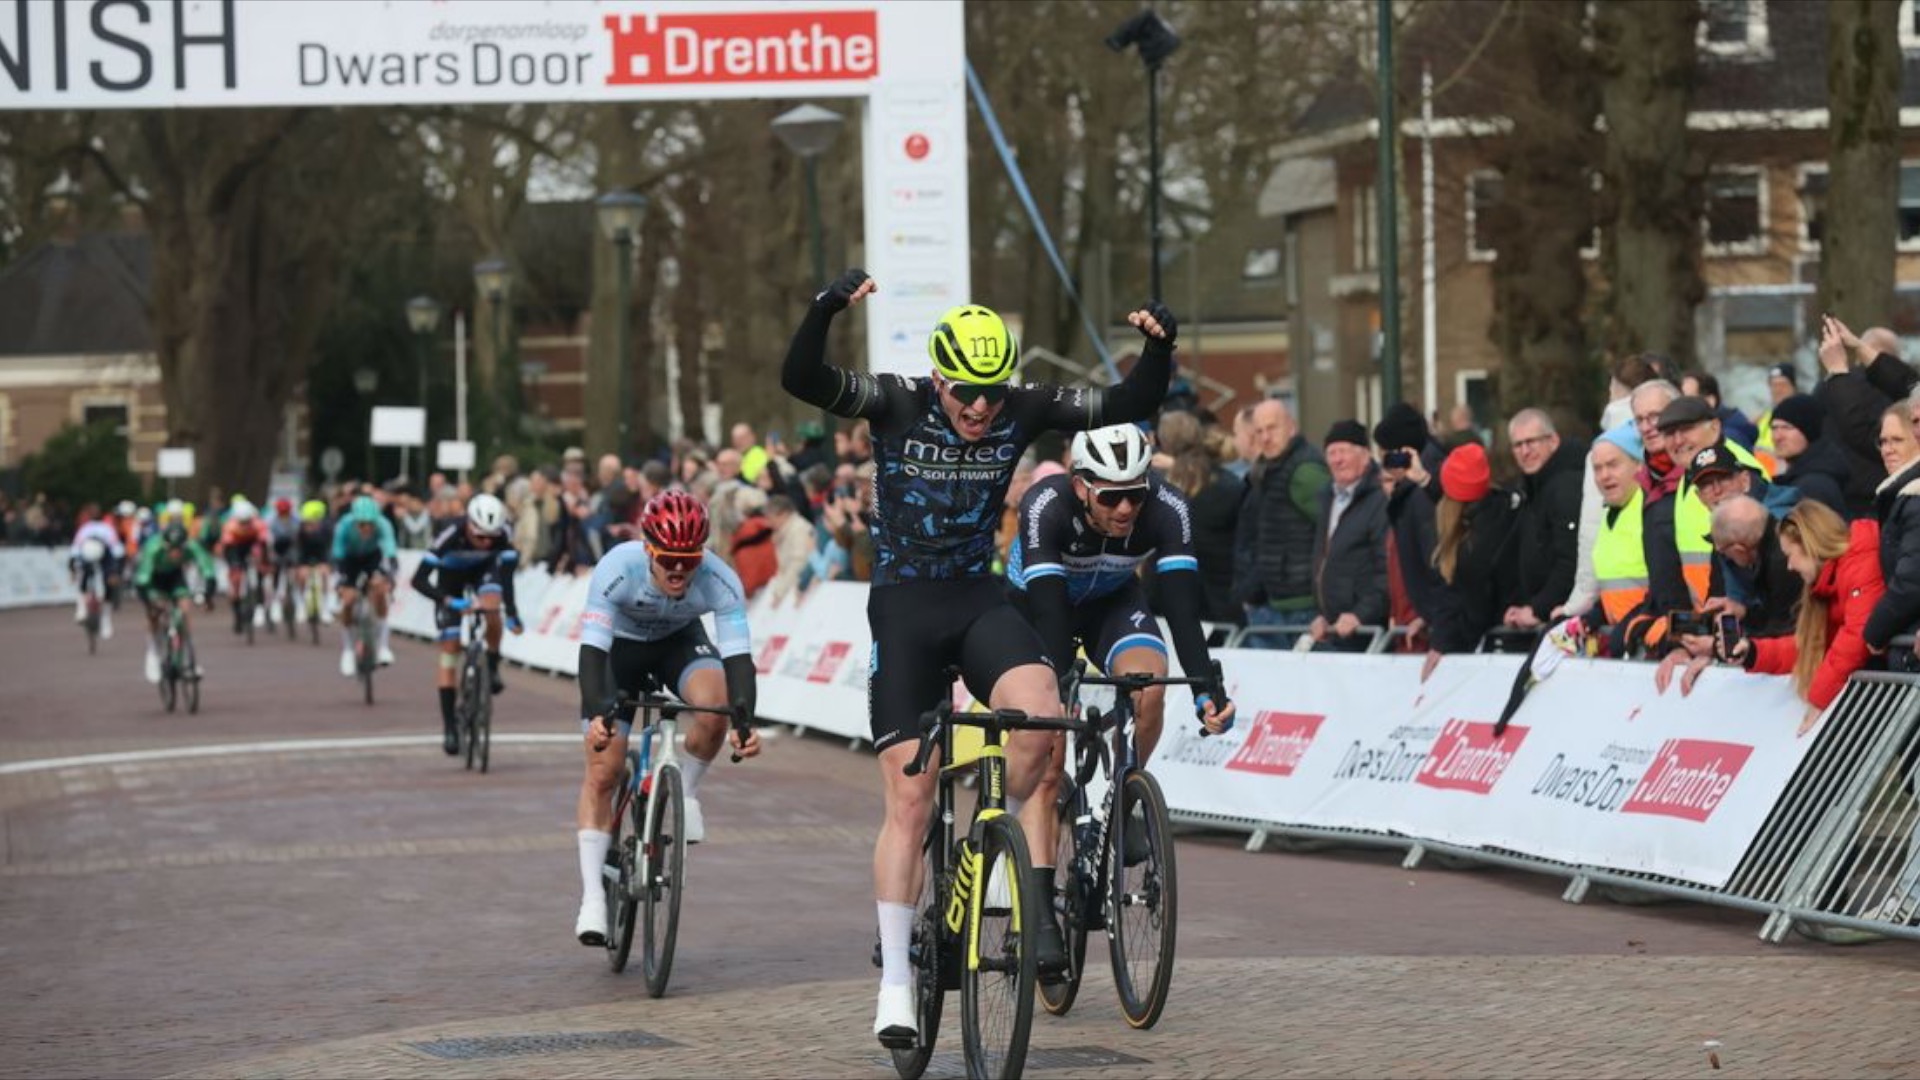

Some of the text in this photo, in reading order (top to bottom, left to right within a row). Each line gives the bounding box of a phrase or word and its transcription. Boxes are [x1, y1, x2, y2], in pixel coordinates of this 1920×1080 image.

[298, 24, 874, 87] Dwars Door Drenthe
[904, 439, 1015, 462] metec
[1434, 736, 1511, 784] Drenthe
[1531, 752, 1598, 803] Dwars
[1645, 755, 1733, 811] Drenthe
